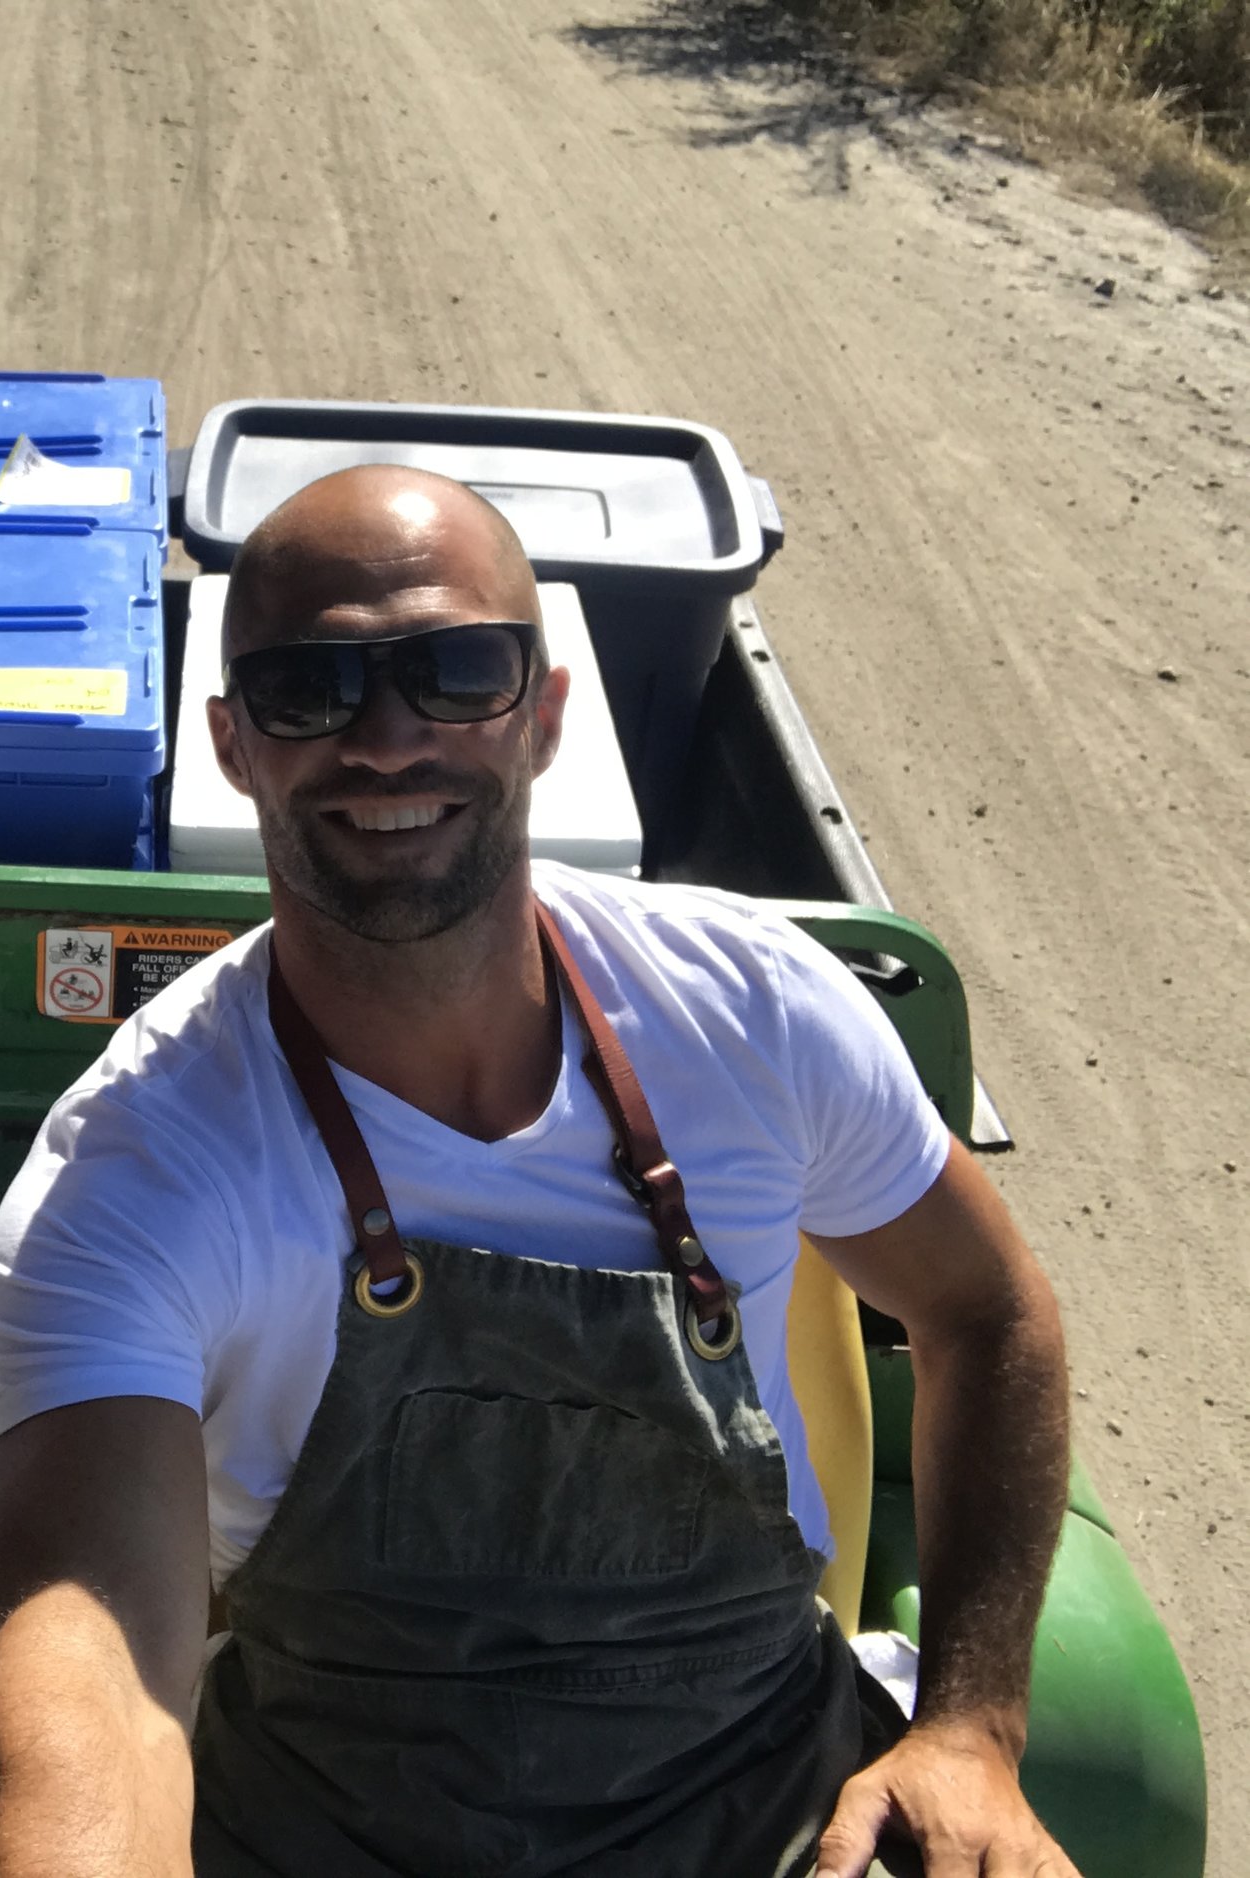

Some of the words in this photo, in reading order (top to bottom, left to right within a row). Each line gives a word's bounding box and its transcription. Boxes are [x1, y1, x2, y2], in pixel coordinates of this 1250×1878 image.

[141, 933, 228, 947] WARNING
[138, 954, 182, 964] RIDERS
[132, 963, 160, 972] FALL
[163, 964, 187, 973] OFF
[142, 973, 158, 982] BE
